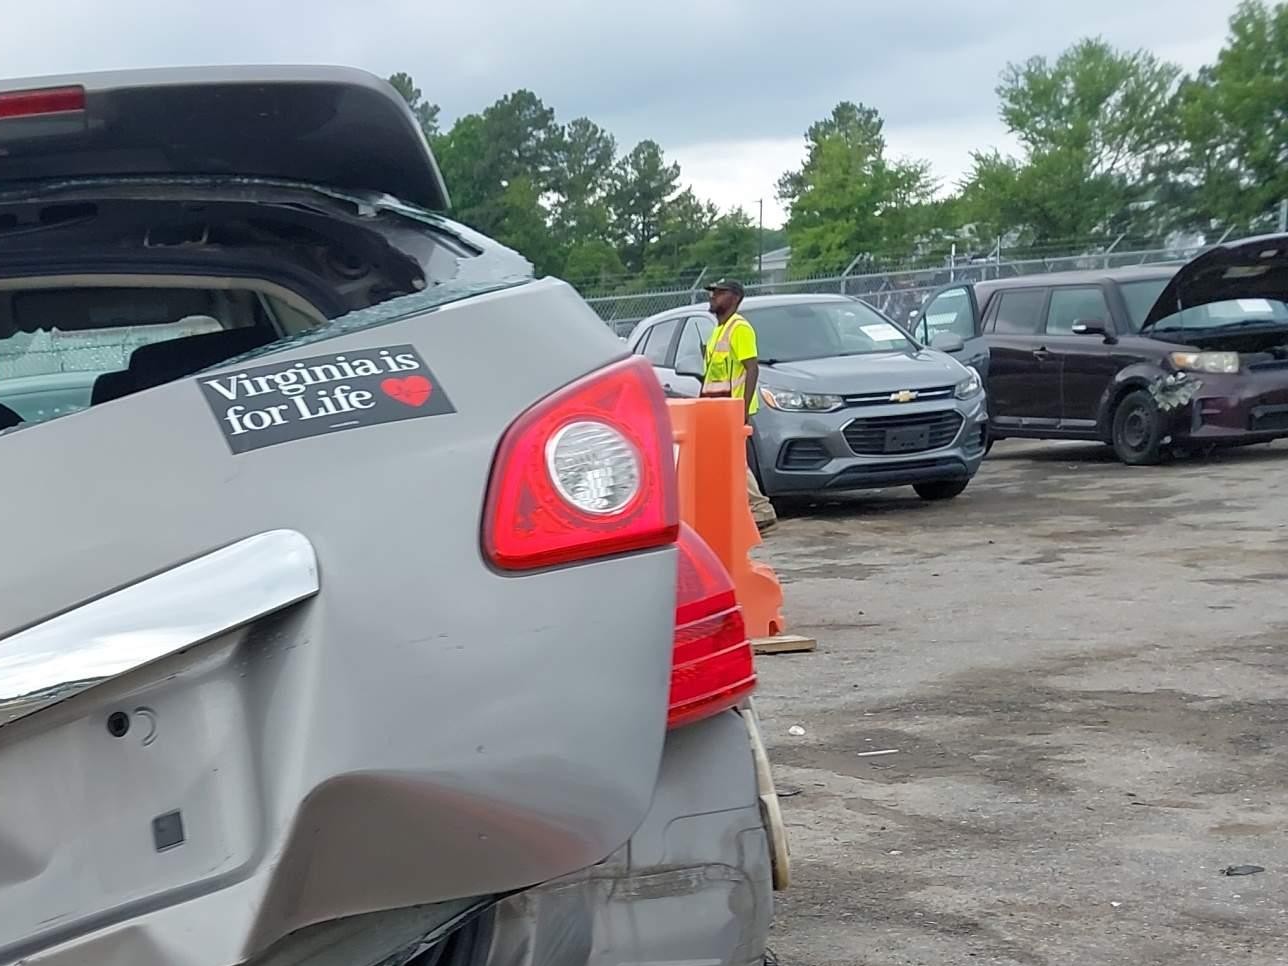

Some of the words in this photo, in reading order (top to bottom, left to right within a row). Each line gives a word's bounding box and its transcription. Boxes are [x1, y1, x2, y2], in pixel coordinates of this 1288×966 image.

[203, 356, 383, 396] Virginia
[379, 350, 420, 372] is
[224, 406, 289, 435] for
[289, 385, 376, 420] Life
